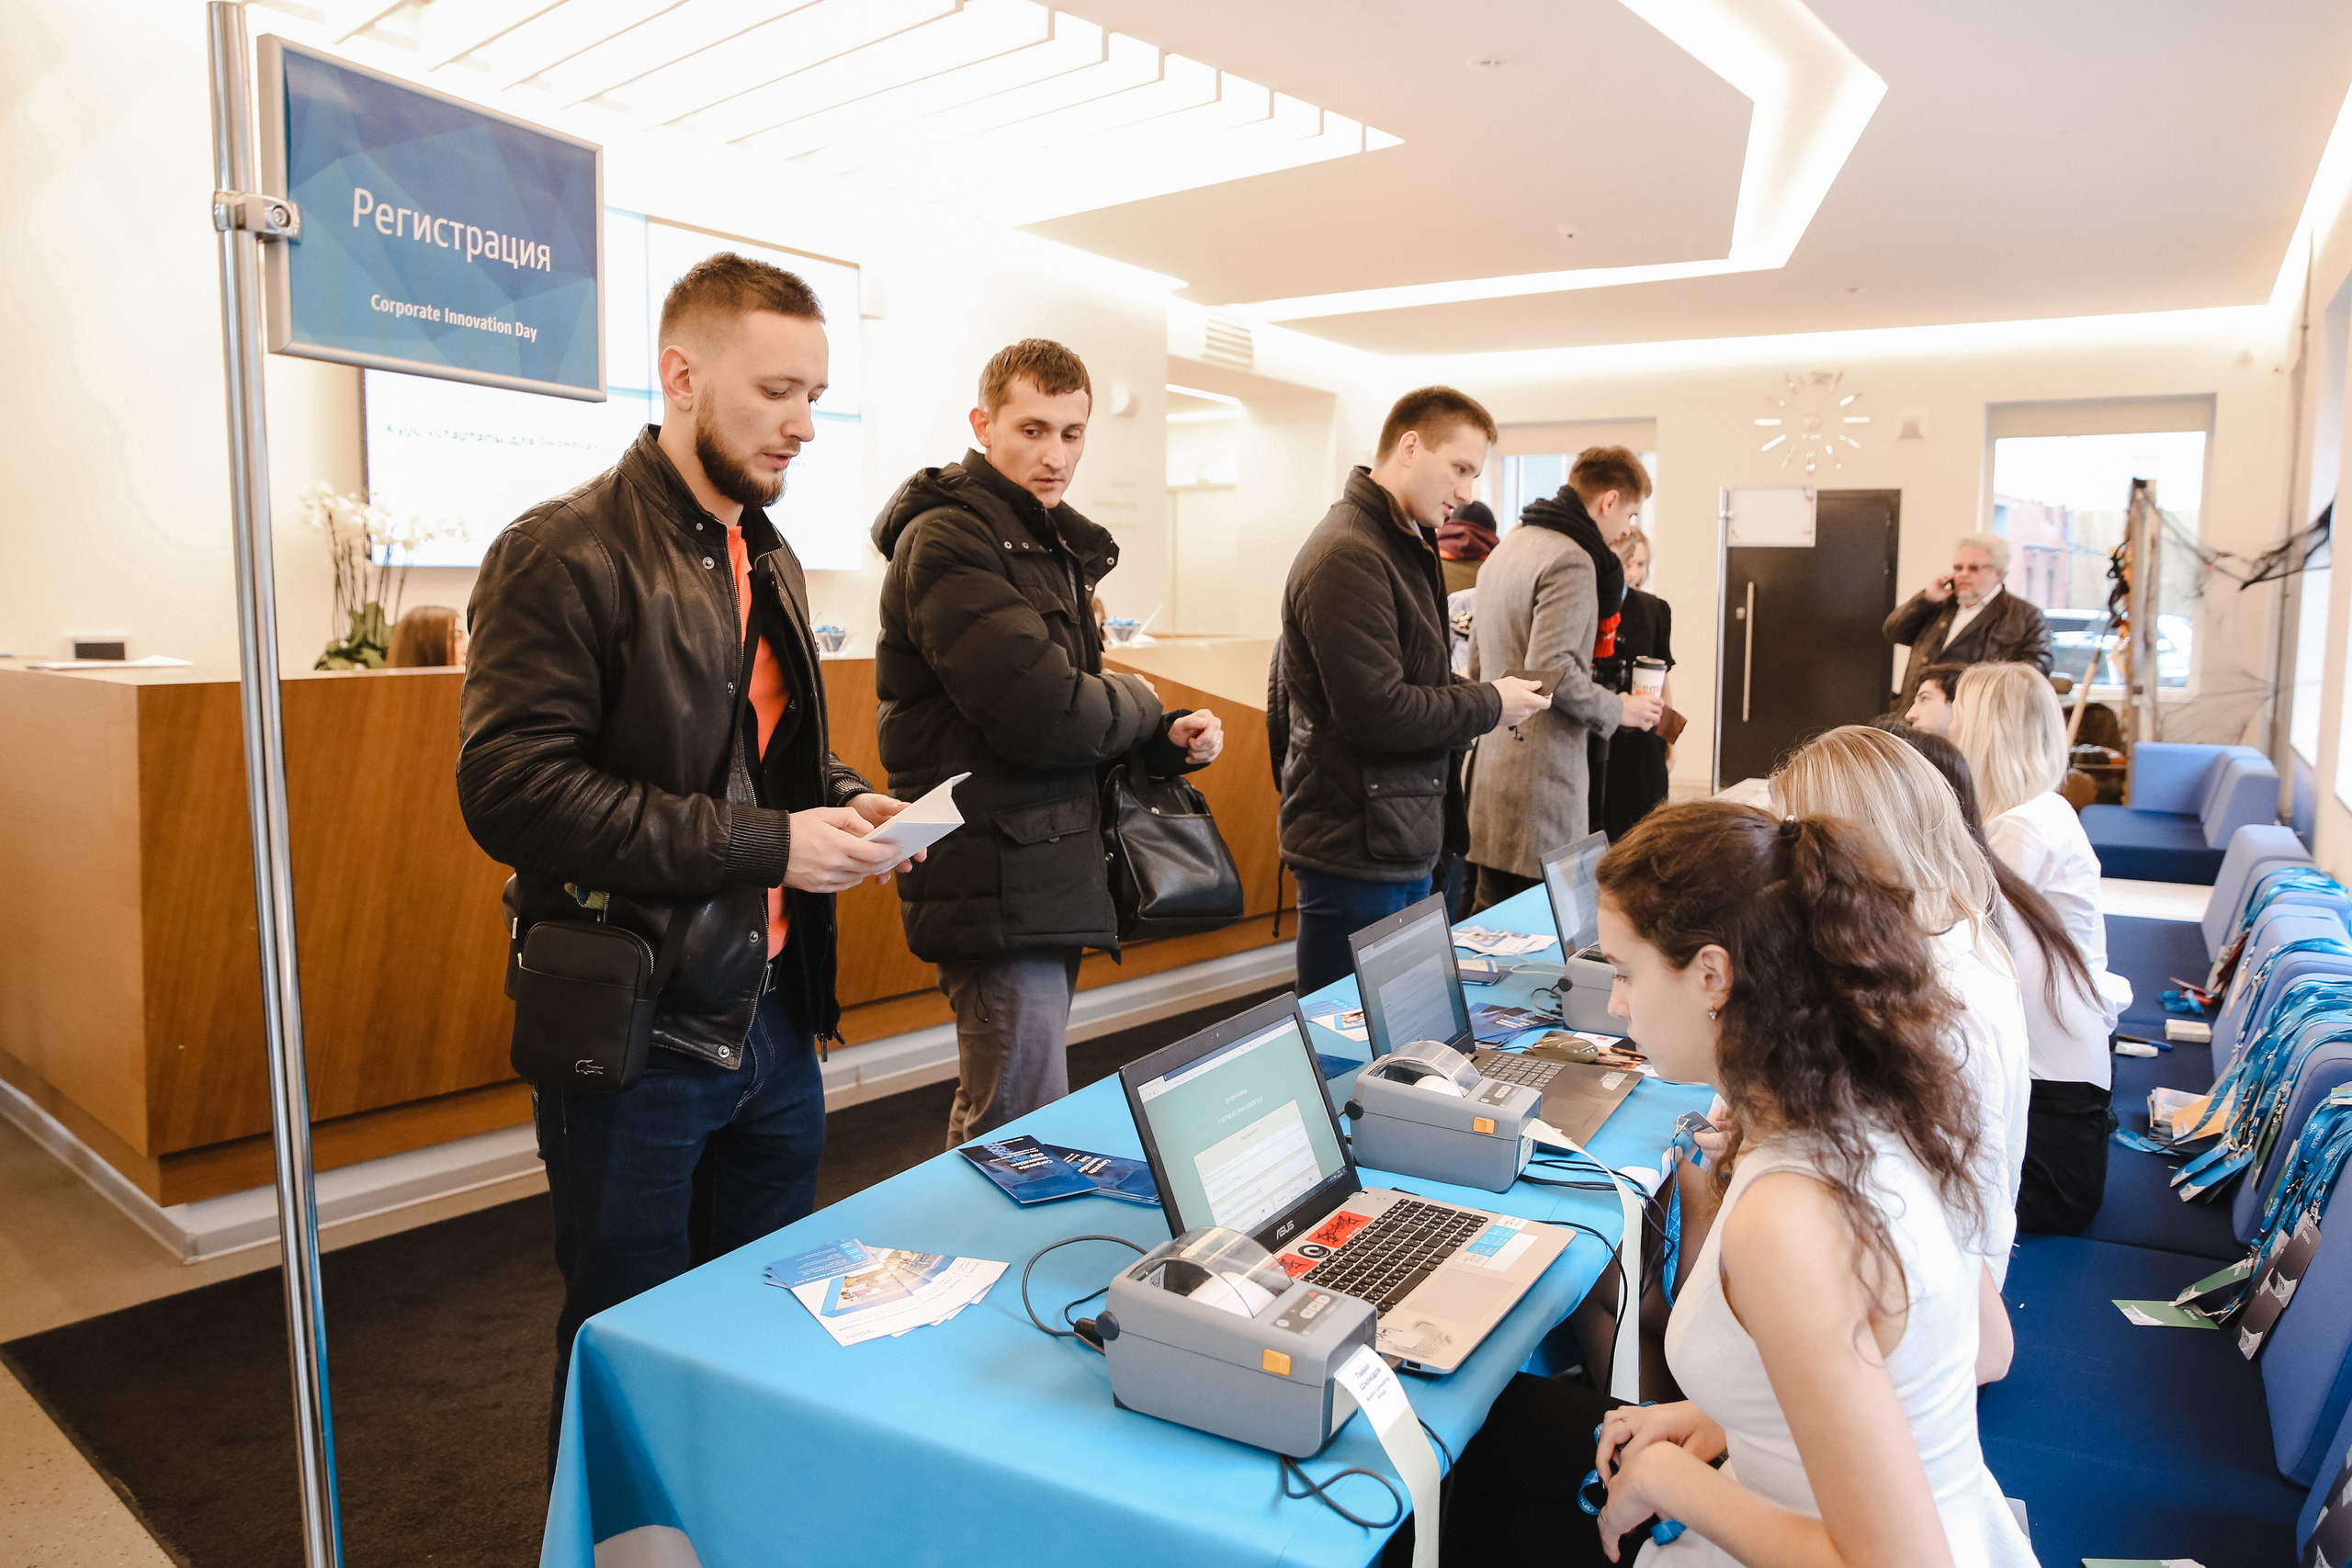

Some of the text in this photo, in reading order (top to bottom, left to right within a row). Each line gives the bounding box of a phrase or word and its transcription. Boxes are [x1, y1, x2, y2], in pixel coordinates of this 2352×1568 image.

[353, 186, 552, 272] Регистрация
[370, 293, 537, 344] Corporate Innovation Day
[1276, 1219, 1295, 1240] ASUS
[1354, 1362, 1371, 1380] Павел
